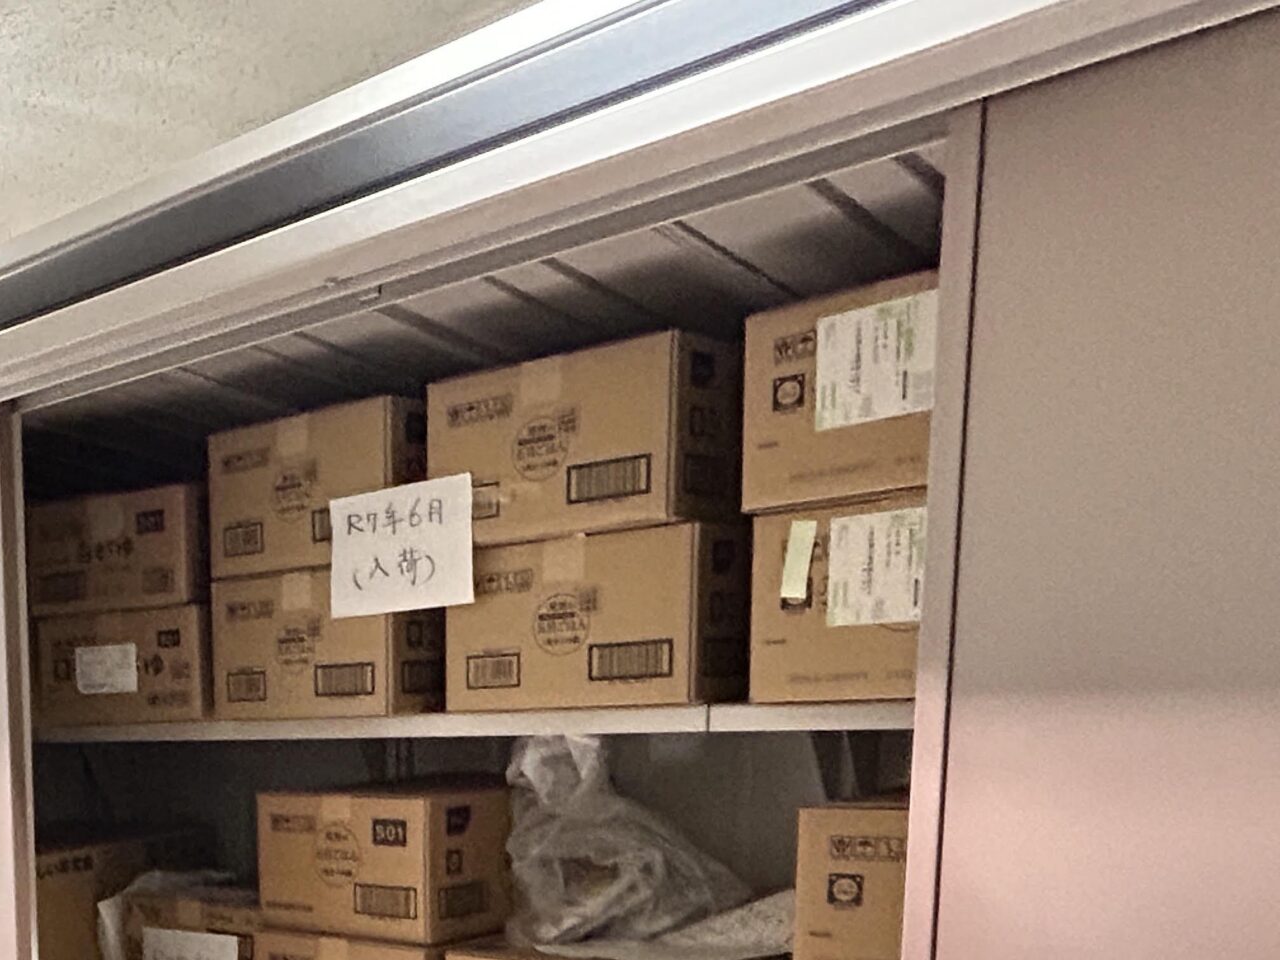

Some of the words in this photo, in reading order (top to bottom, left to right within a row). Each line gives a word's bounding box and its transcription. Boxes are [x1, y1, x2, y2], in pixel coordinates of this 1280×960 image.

[347, 498, 443, 535] R7年6月
[353, 547, 435, 591] (入荷)
[375, 824, 404, 842] 501
